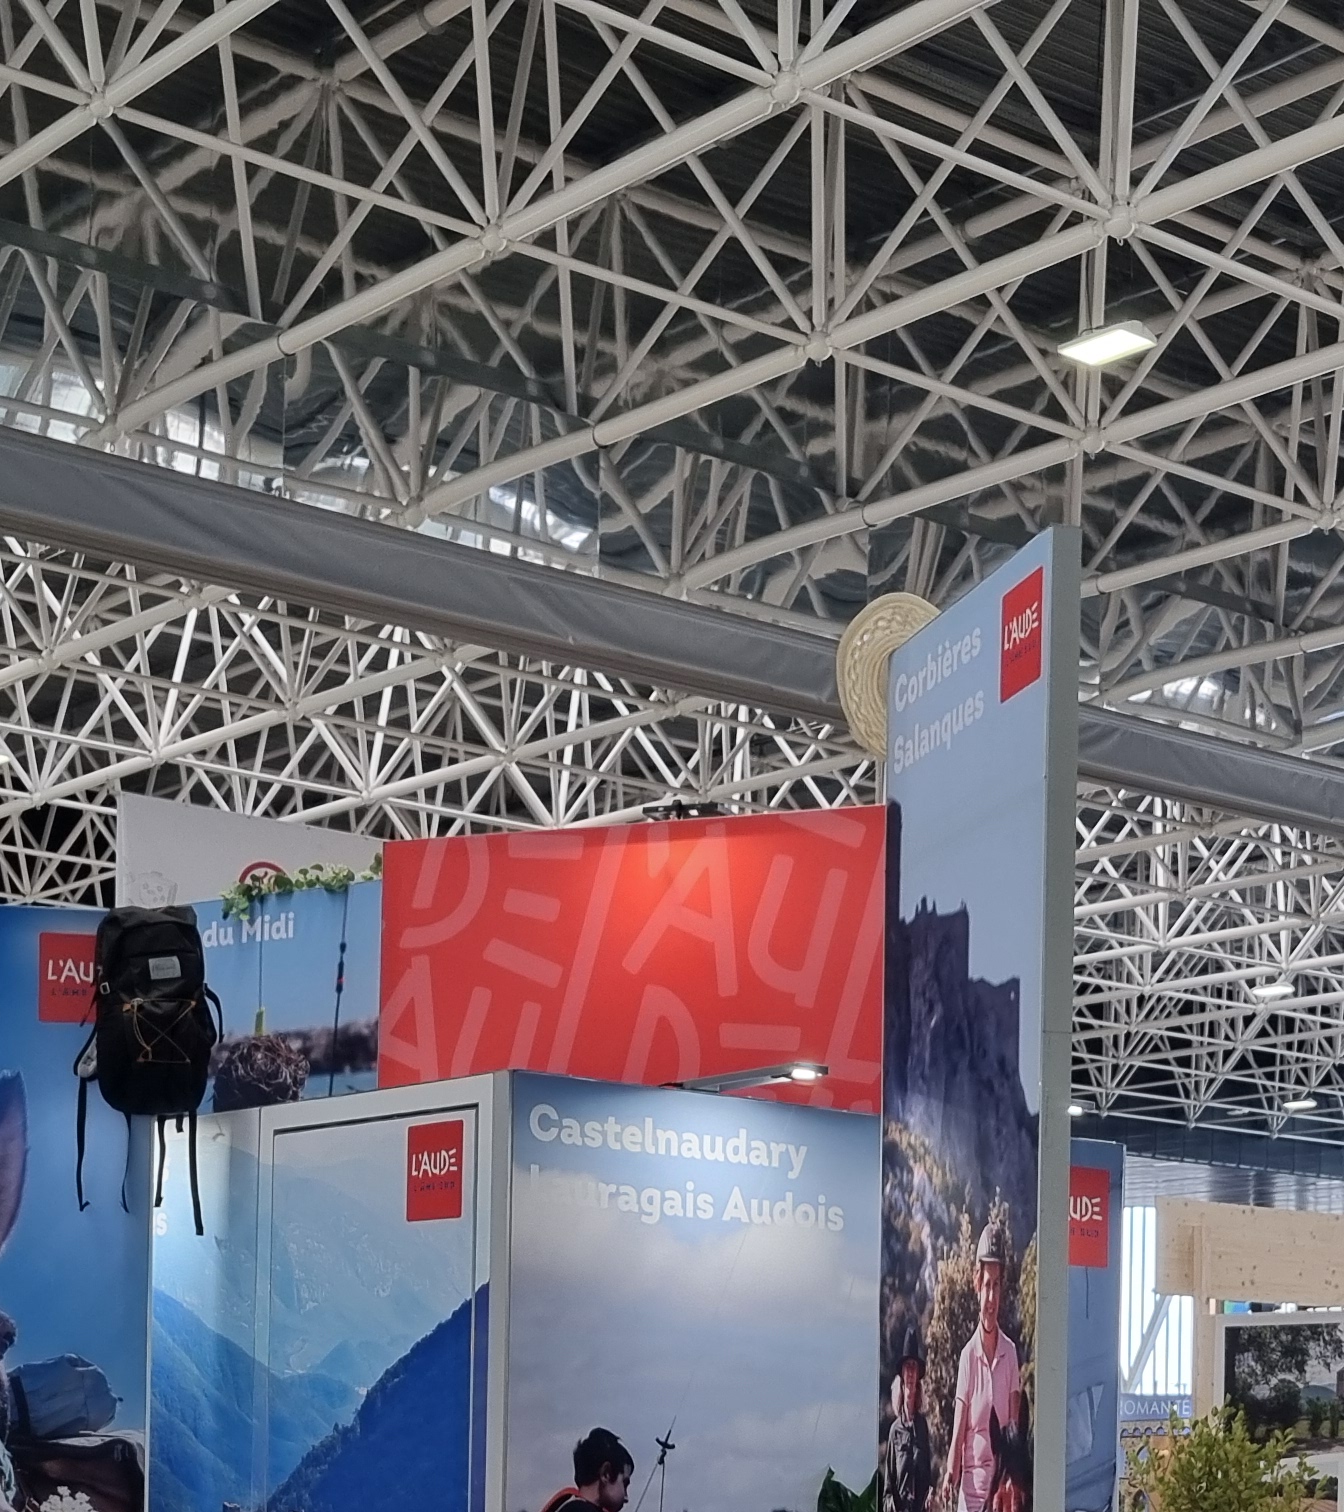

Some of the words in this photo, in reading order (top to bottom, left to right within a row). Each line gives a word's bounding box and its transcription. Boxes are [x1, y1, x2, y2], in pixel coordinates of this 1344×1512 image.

[1004, 601, 1039, 650] L'AUDE
[895, 627, 981, 712] Corbières
[893, 690, 985, 774] Salanques
[203, 921, 234, 947] du
[241, 912, 295, 943] Midi
[47, 958, 94, 984] L'AU
[529, 1103, 807, 1180] Castelnaudary
[411, 1148, 458, 1178] L'AUDE
[529, 1163, 715, 1224] Luragais
[722, 1185, 845, 1232] Audois
[1068, 1195, 1103, 1221] UDE
[1119, 1397, 1190, 1416] OMANTÉ
